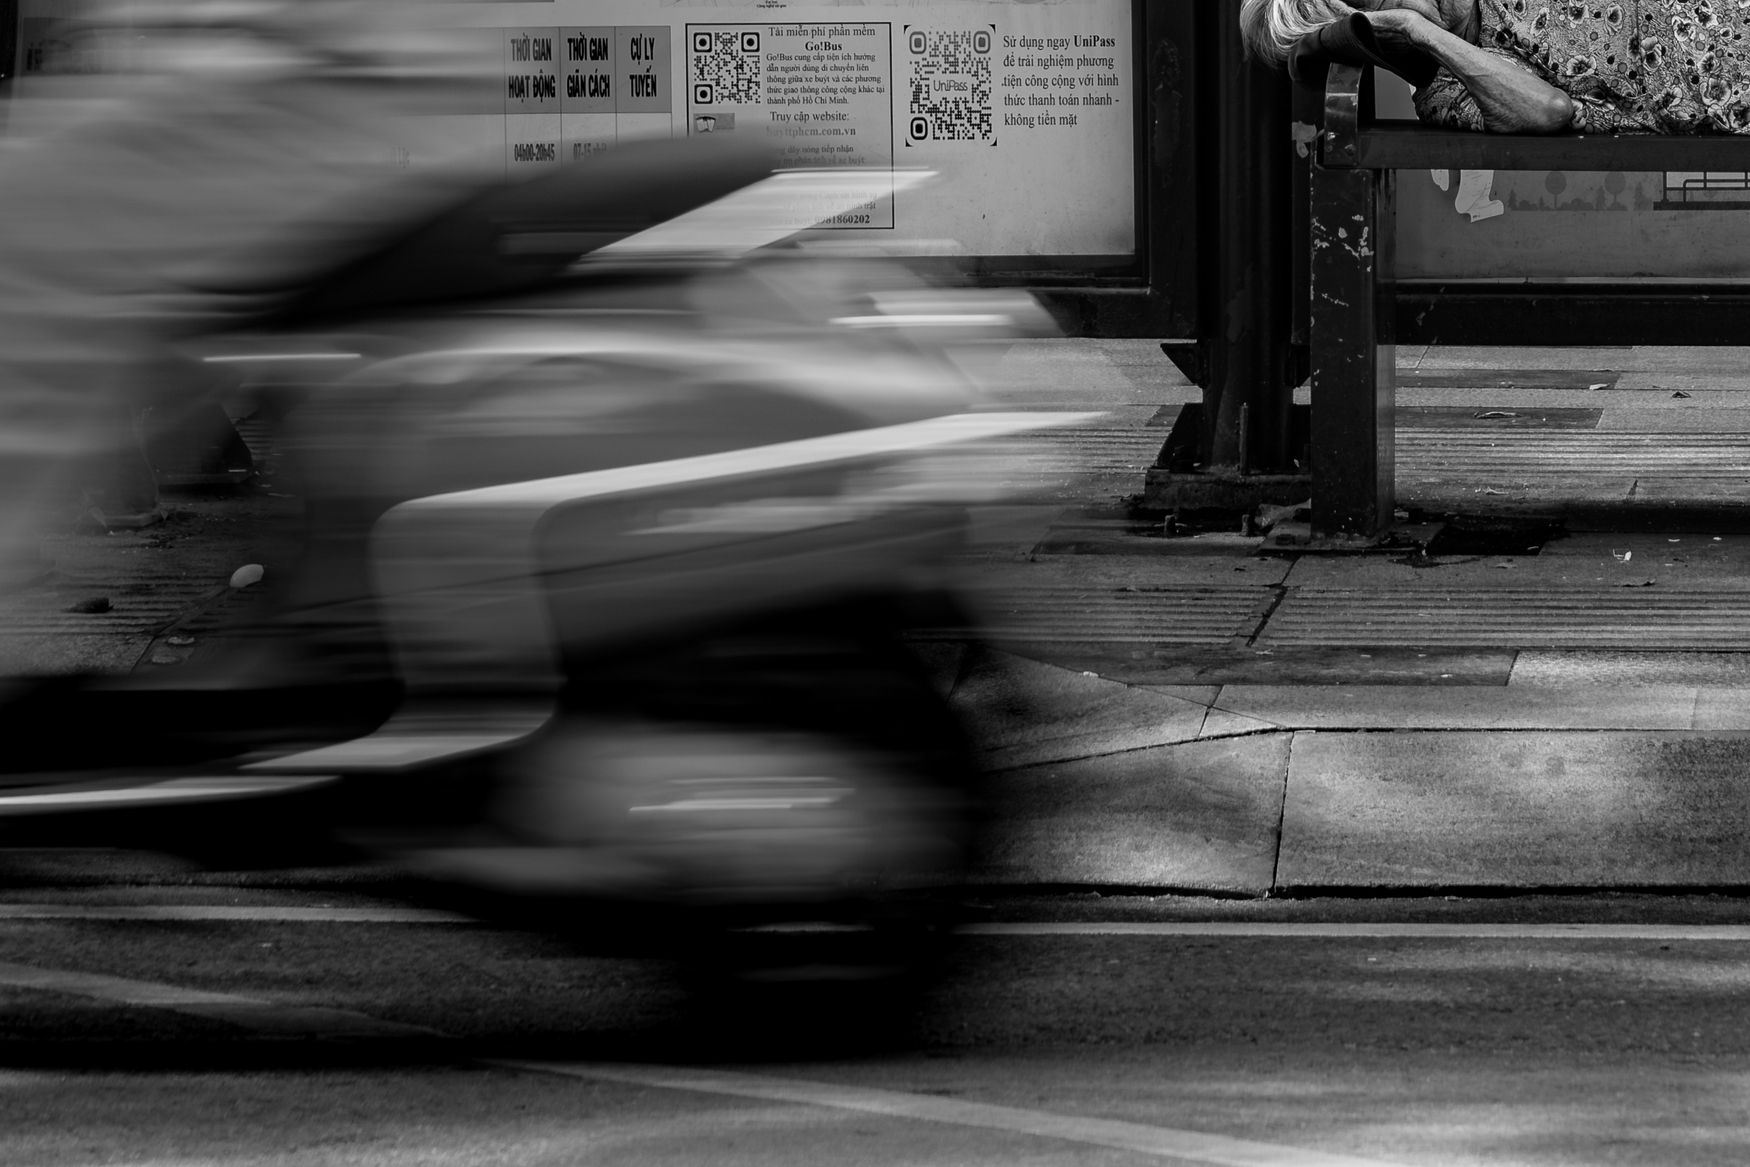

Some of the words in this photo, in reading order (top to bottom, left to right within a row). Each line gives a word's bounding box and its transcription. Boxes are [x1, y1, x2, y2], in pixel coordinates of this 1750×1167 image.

[631, 33, 642, 65] CỰ
[644, 37, 654, 60] LY
[1003, 35, 1016, 48] Sử
[1020, 35, 1044, 51] dụng
[1047, 38, 1070, 50] ngay
[1074, 35, 1115, 47] UniPass
[1003, 51, 1015, 67] để
[1018, 54, 1034, 67] trải
[1037, 54, 1074, 70] nghiệm
[1077, 54, 1114, 70] phương
[629, 65, 656, 97] TUYẾN
[933, 80, 968, 92] UniPass
[1004, 113, 1035, 129] không
[1038, 110, 1056, 125] tiền
[1059, 114, 1077, 127] mặt
